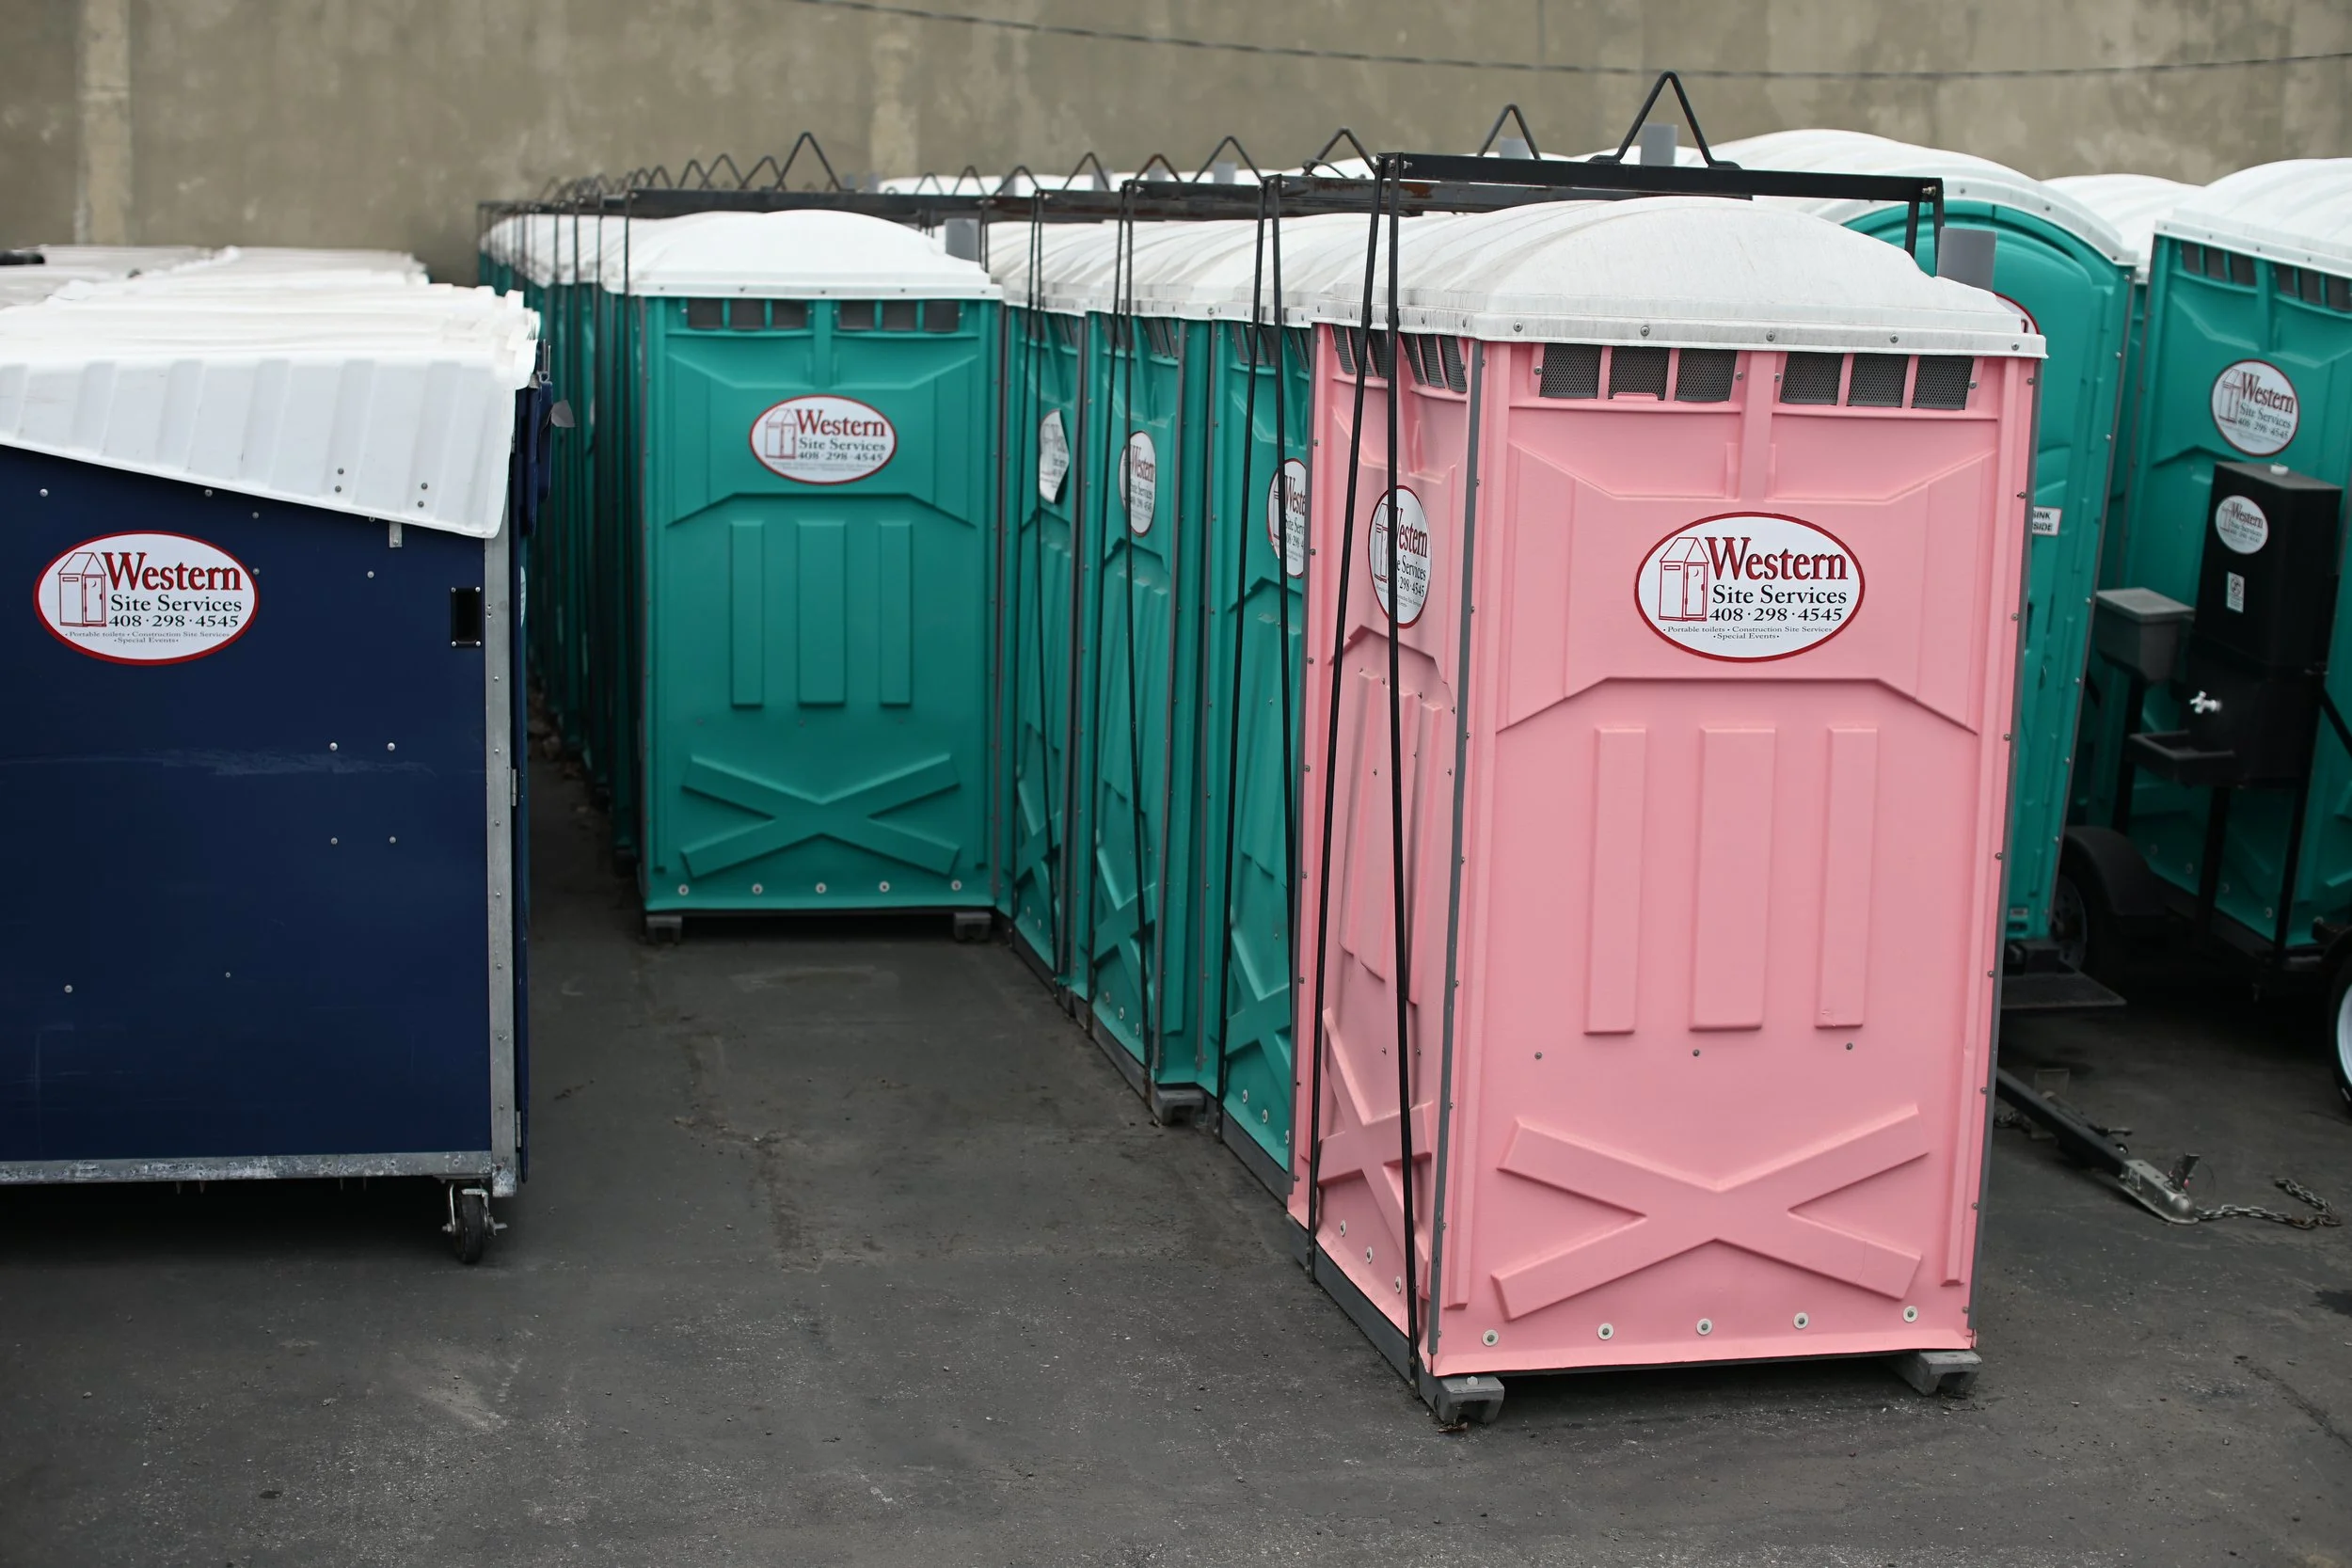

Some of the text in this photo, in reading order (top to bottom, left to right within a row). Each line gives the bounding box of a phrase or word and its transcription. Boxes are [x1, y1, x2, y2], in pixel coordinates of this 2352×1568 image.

[2242, 372, 2296, 414] Western
[795, 409, 886, 437] Western
[2258, 407, 2292, 429] Services
[800, 437, 886, 451] Site Services
[1285, 475, 1306, 515] Weste
[101, 551, 243, 591] Western
[1402, 554, 1426, 581] Services
[1704, 536, 1849, 580] Western
[110, 594, 243, 612] Site Services
[1712, 584, 1847, 604] Site Services
